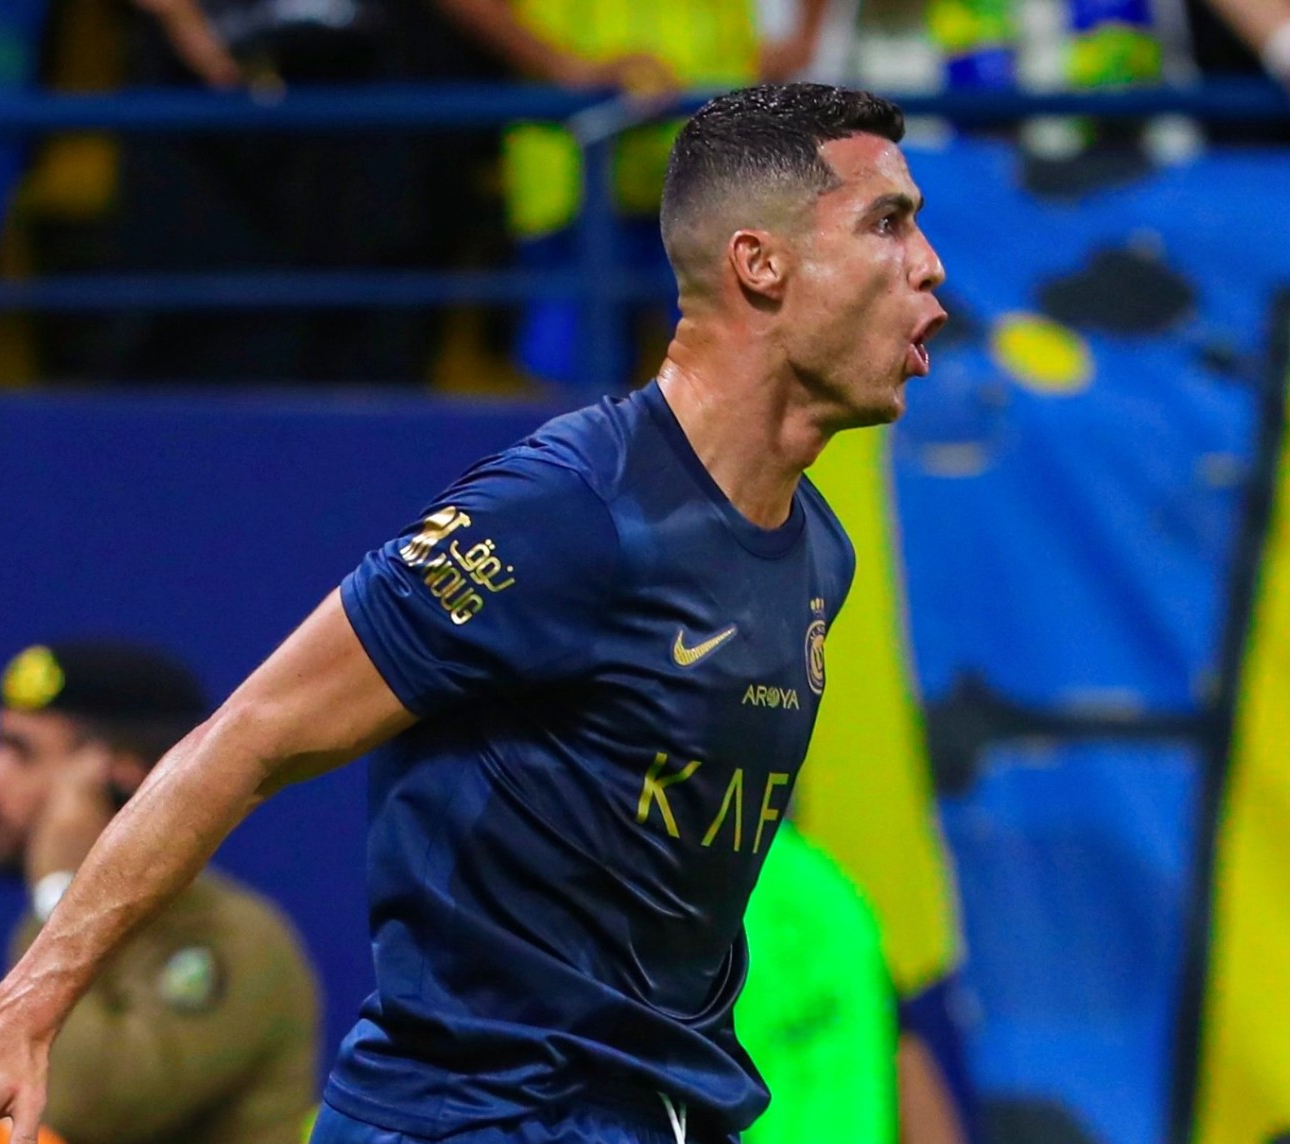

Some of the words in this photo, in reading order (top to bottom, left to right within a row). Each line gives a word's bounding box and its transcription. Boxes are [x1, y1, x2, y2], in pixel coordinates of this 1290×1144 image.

[423, 552, 484, 625] NOUG
[450, 539, 515, 592] نوق
[741, 683, 800, 711] AROYA
